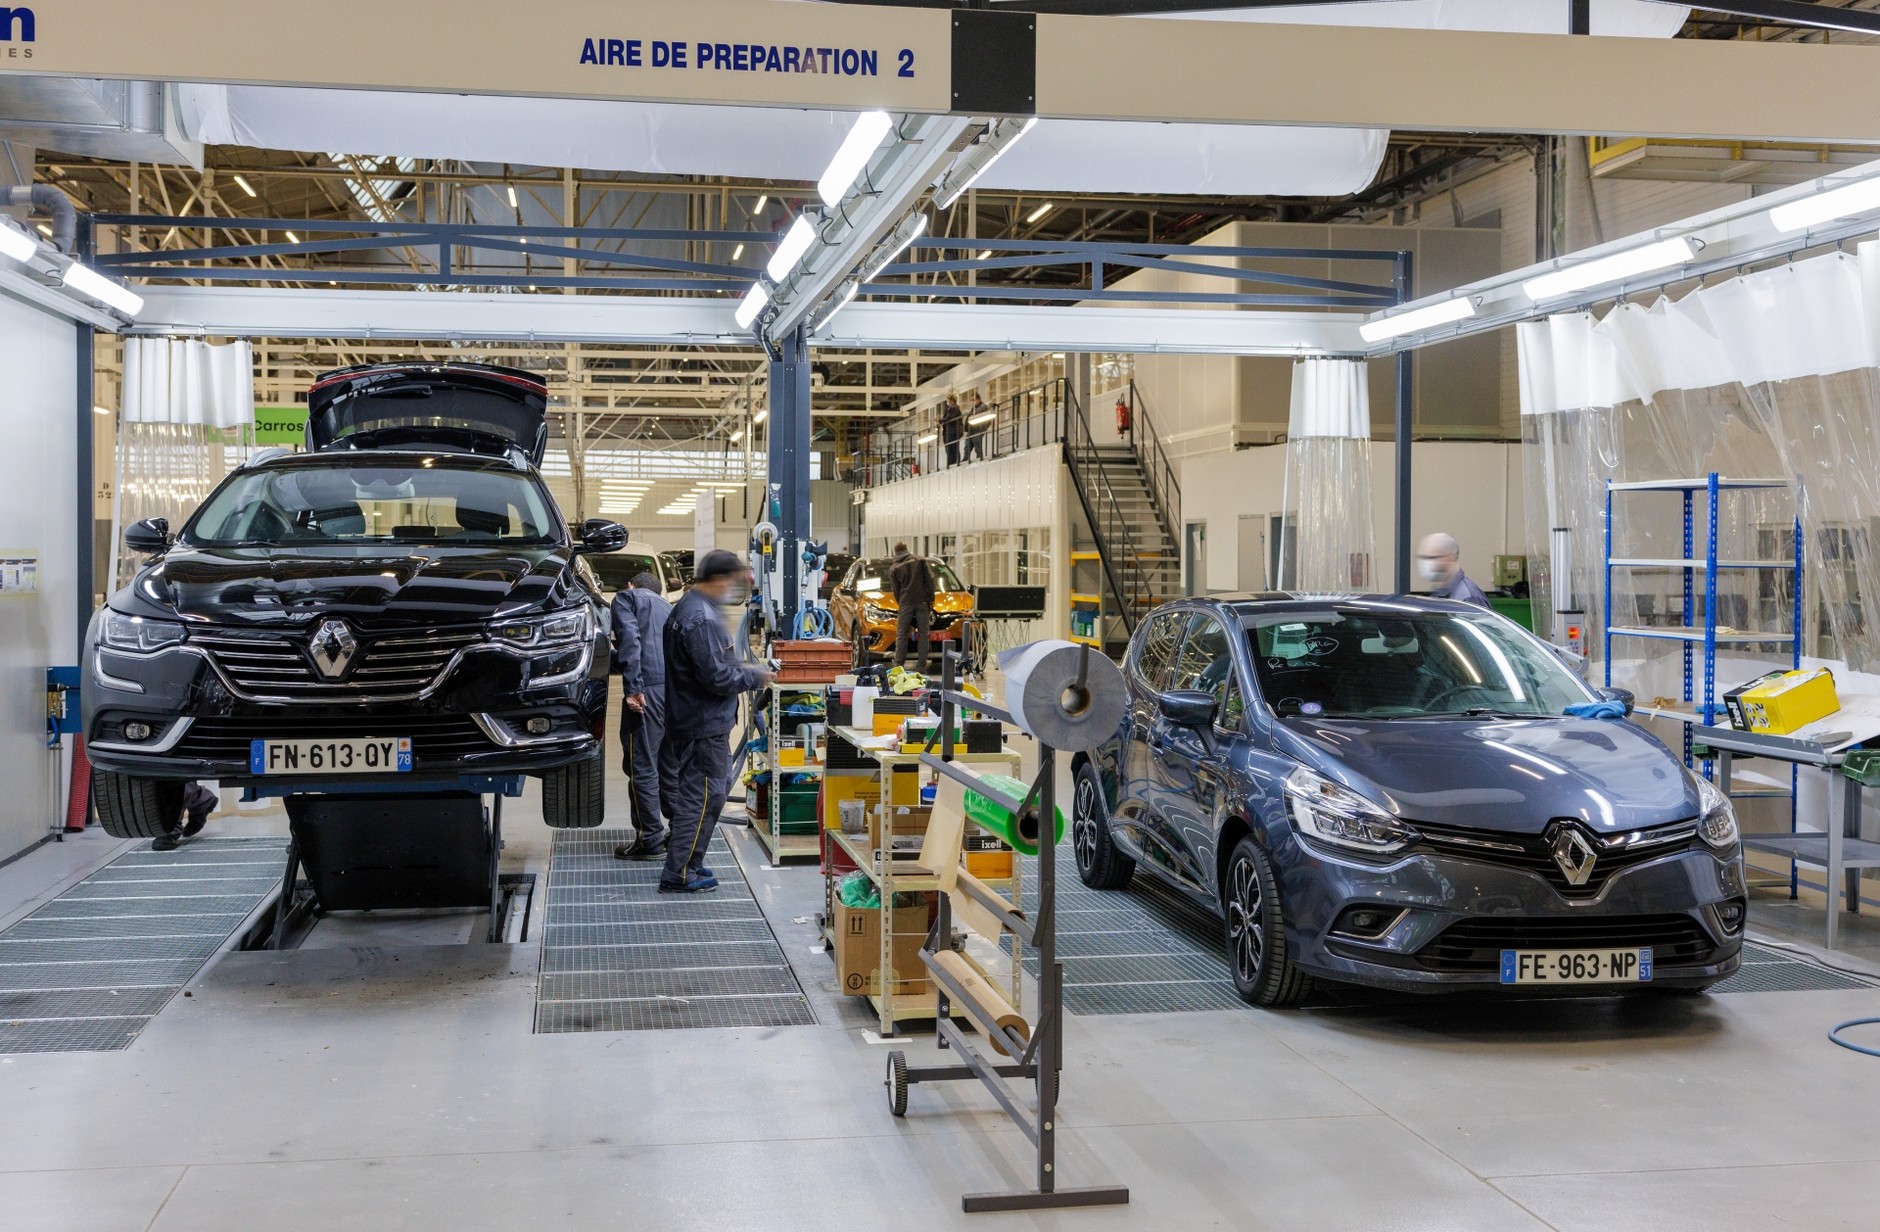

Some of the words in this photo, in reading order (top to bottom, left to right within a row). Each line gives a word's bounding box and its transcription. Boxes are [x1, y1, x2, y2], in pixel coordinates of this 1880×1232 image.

[0, 47, 33, 59] ES
[580, 38, 642, 67] AIRE
[652, 40, 687, 68] DE
[697, 43, 877, 76] PREPARATION
[897, 48, 915, 78] 2
[255, 420, 304, 432] Carros
[1727, 701, 1744, 727] ixell
[255, 757, 260, 765] F
[269, 742, 393, 769] FN-613-QY
[398, 753, 411, 765] 78
[981, 839, 1002, 849] ixell
[1506, 969, 1511, 977] F
[1519, 952, 1637, 980] FE-963-NP
[1640, 965, 1651, 977] 51
